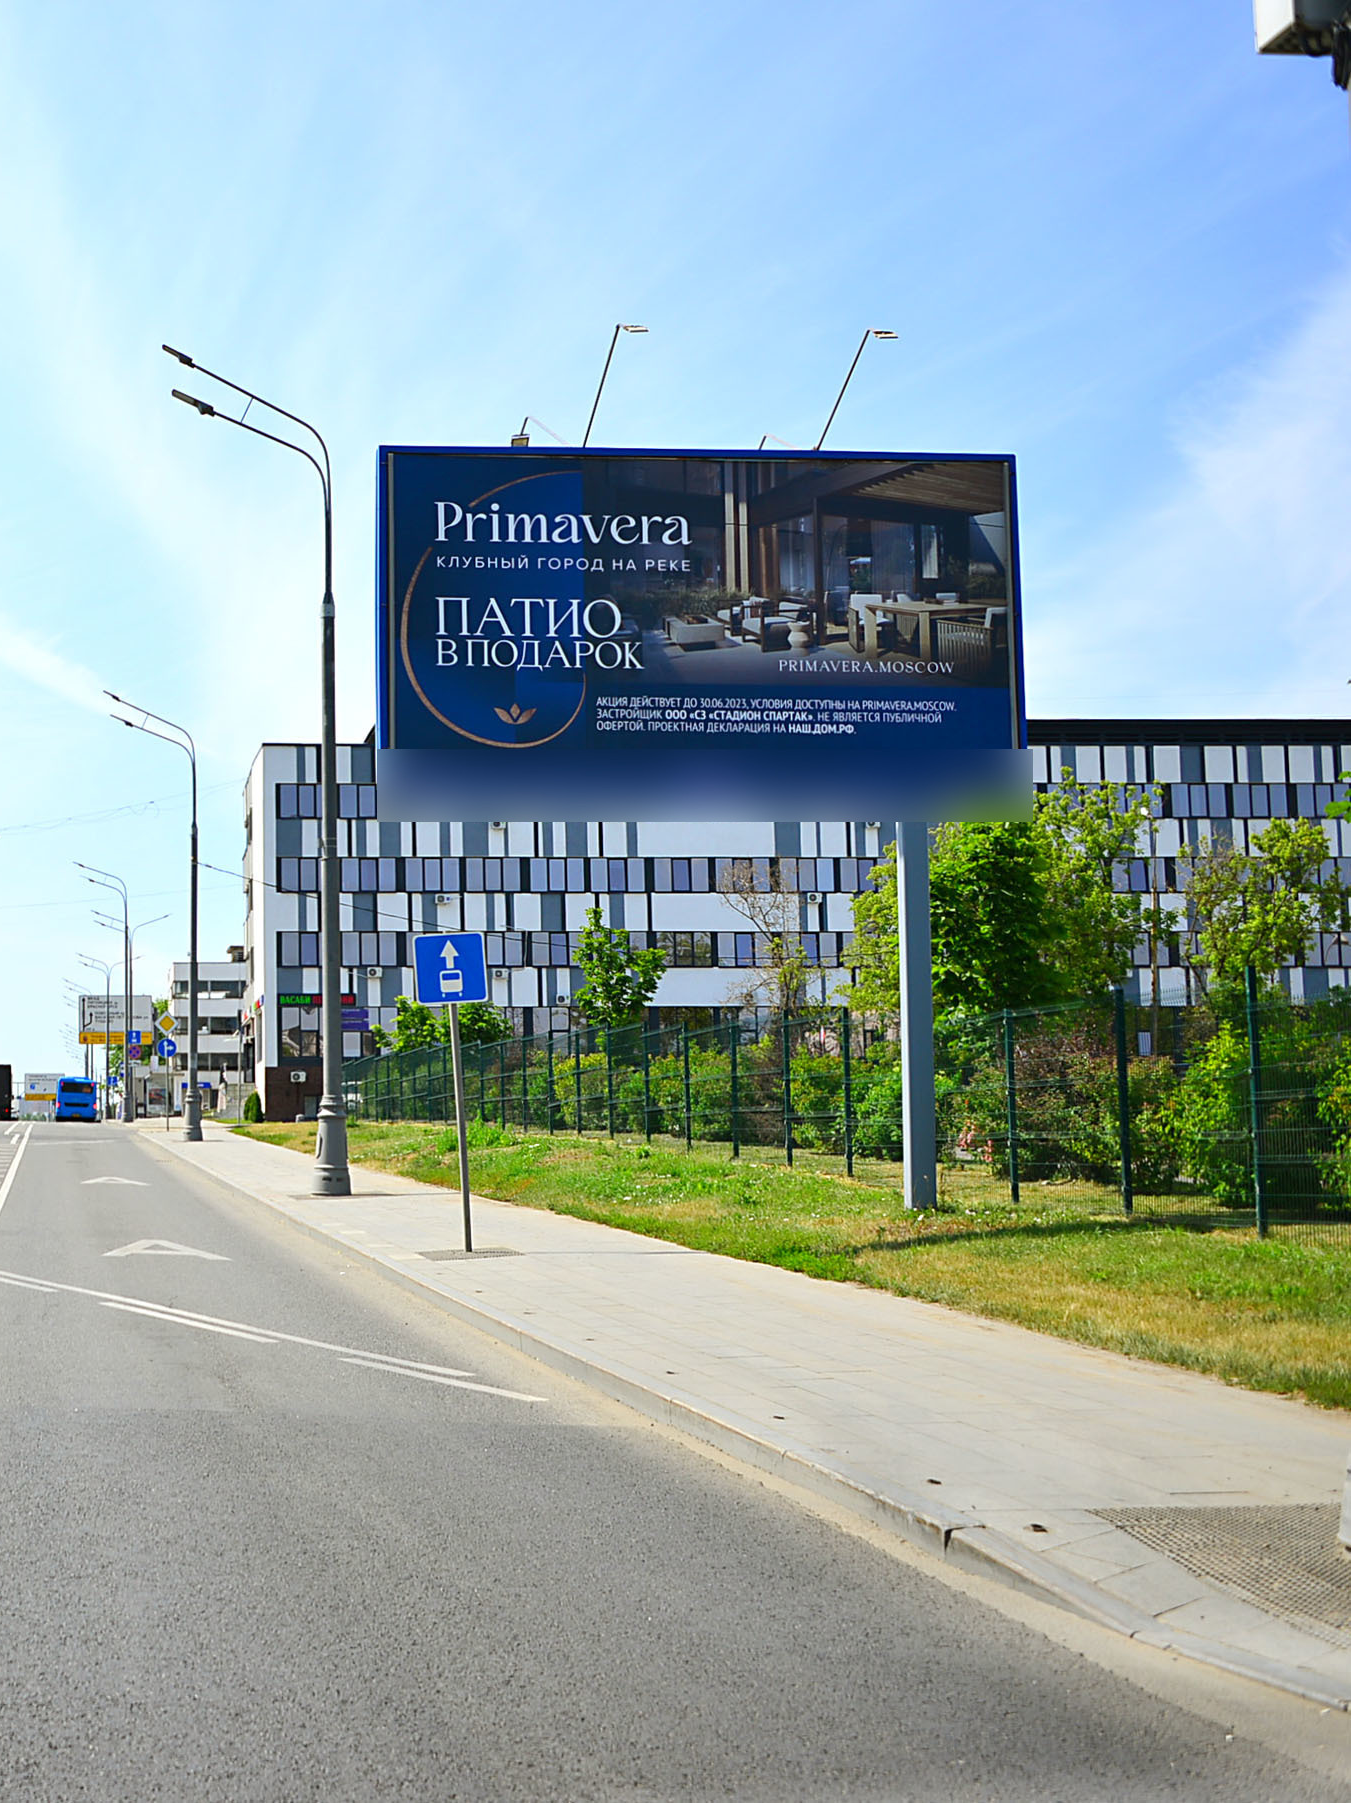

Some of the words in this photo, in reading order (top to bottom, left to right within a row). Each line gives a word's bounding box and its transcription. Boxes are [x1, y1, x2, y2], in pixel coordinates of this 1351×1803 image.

[434, 501, 692, 546] Primavera
[436, 554, 529, 570] КЛУБНЫЙ
[537, 557, 604, 572] ГОРОД
[612, 559, 637, 571] НА
[645, 560, 691, 572] РЕКЕ
[435, 597, 622, 639] ПАТИО
[435, 639, 459, 667] В
[465, 639, 645, 672] ПОДАРОК
[778, 659, 955, 674] PRIMAVERA.MOSCOW
[596, 697, 627, 708] АКЦИЯ
[629, 696, 681, 708] ДЕЙСТВУЕТ
[683, 698, 697, 709] ДО
[700, 698, 749, 710] 30.06.2023,
[751, 699, 793, 709] УСЛОВИЯ
[794, 699, 846, 710] ДОСТУПНЫ
[847, 700, 860, 710] НА
[862, 701, 957, 712] PRIMAVERA.MOSCOW.
[596, 708, 663, 720] ЗАСТРОЙЩИК
[665, 709, 687, 720] ООО
[689, 710, 706, 720] «СЗ
[708, 710, 761, 721] «СТАДИОН
[763, 711, 816, 721] СПАРТАК».
[818, 712, 830, 721] НЕ
[832, 712, 880, 722] ЯВЛЯЕТСЯ
[883, 711, 942, 723] ПУБЛИЧНОЙ
[596, 720, 646, 731] ОФЕРТОЙ.
[648, 721, 704, 732] ПРОЕКТНАЯ
[706, 722, 770, 733] ДЕКЛАРАЦИЯ
[773, 723, 786, 733] НА
[280, 995, 311, 1004] ВАСАБИ
